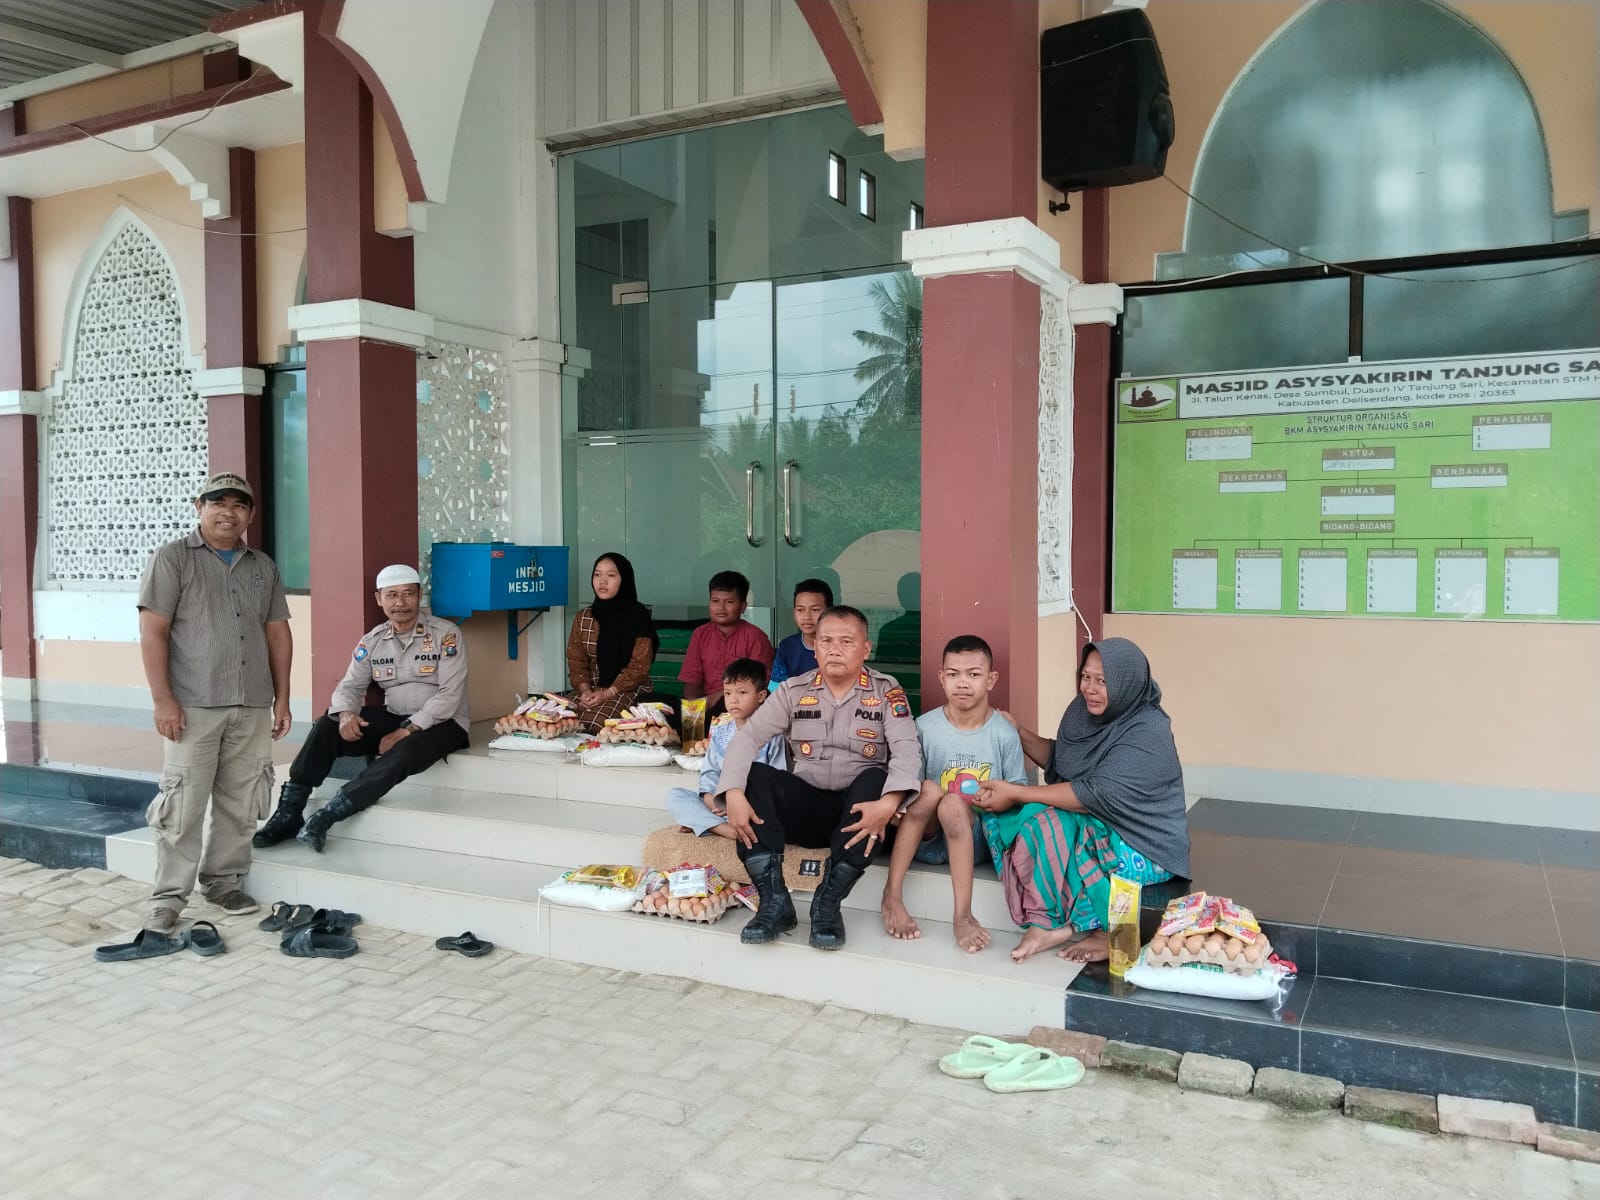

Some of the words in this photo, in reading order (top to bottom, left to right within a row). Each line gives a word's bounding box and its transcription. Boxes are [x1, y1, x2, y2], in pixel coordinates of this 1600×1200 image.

[1186, 379, 1269, 396] MASJID
[1275, 369, 1433, 390] ASYSYAKIRIN
[1440, 361, 1561, 380] TANJUNG
[1568, 360, 1600, 373] SA
[1274, 391, 1301, 399] Desa
[1353, 386, 1390, 395] Dusun
[1408, 383, 1456, 393] Tanjung
[1487, 377, 1560, 388] Kecamatan
[1563, 375, 1590, 384] STM
[1278, 398, 1339, 408] Kabupaten
[1416, 392, 1446, 401] kode
[1448, 392, 1471, 401] pos
[1479, 389, 1516, 398] 20363
[1306, 414, 1353, 424] STRUKTUR
[1355, 411, 1411, 421] ORGANISASI
[1478, 413, 1545, 424] PENASEHAT
[1284, 426, 1304, 435] BKM
[1306, 423, 1364, 433] ASYSYAKIRIN
[1366, 421, 1409, 431] TANJUNG
[1412, 420, 1434, 430] SARI
[1341, 450, 1375, 459] KETUA
[1222, 472, 1284, 483] SEKRETARIS
[1436, 466, 1503, 476] BENDAHARA
[1340, 487, 1376, 495] HUMAS
[1322, 521, 1393, 531] BIDANG-BIDANG
[516, 566, 544, 579] INFQ
[508, 580, 545, 593] MESJID
[414, 653, 441, 662] POLRI
[855, 708, 883, 722] POLRI
